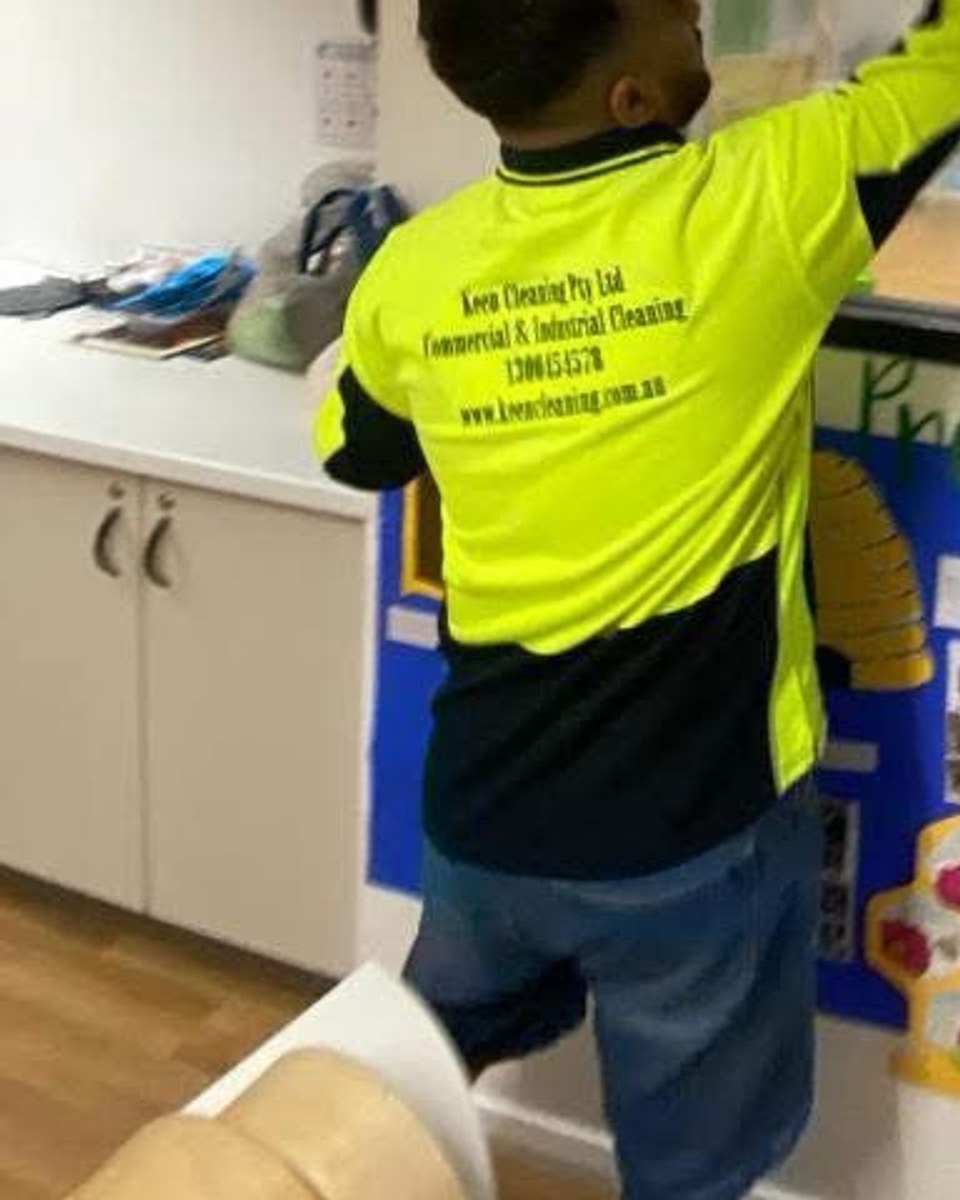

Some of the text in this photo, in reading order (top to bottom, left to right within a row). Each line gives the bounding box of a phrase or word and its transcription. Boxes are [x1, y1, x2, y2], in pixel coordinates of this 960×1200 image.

[462, 265, 624, 316] Keen Cleaning Pty Ltd
[423, 297, 686, 358] Commercial & Industrial Cleaning
[461, 376, 666, 425] www.keencleaning.com.au
